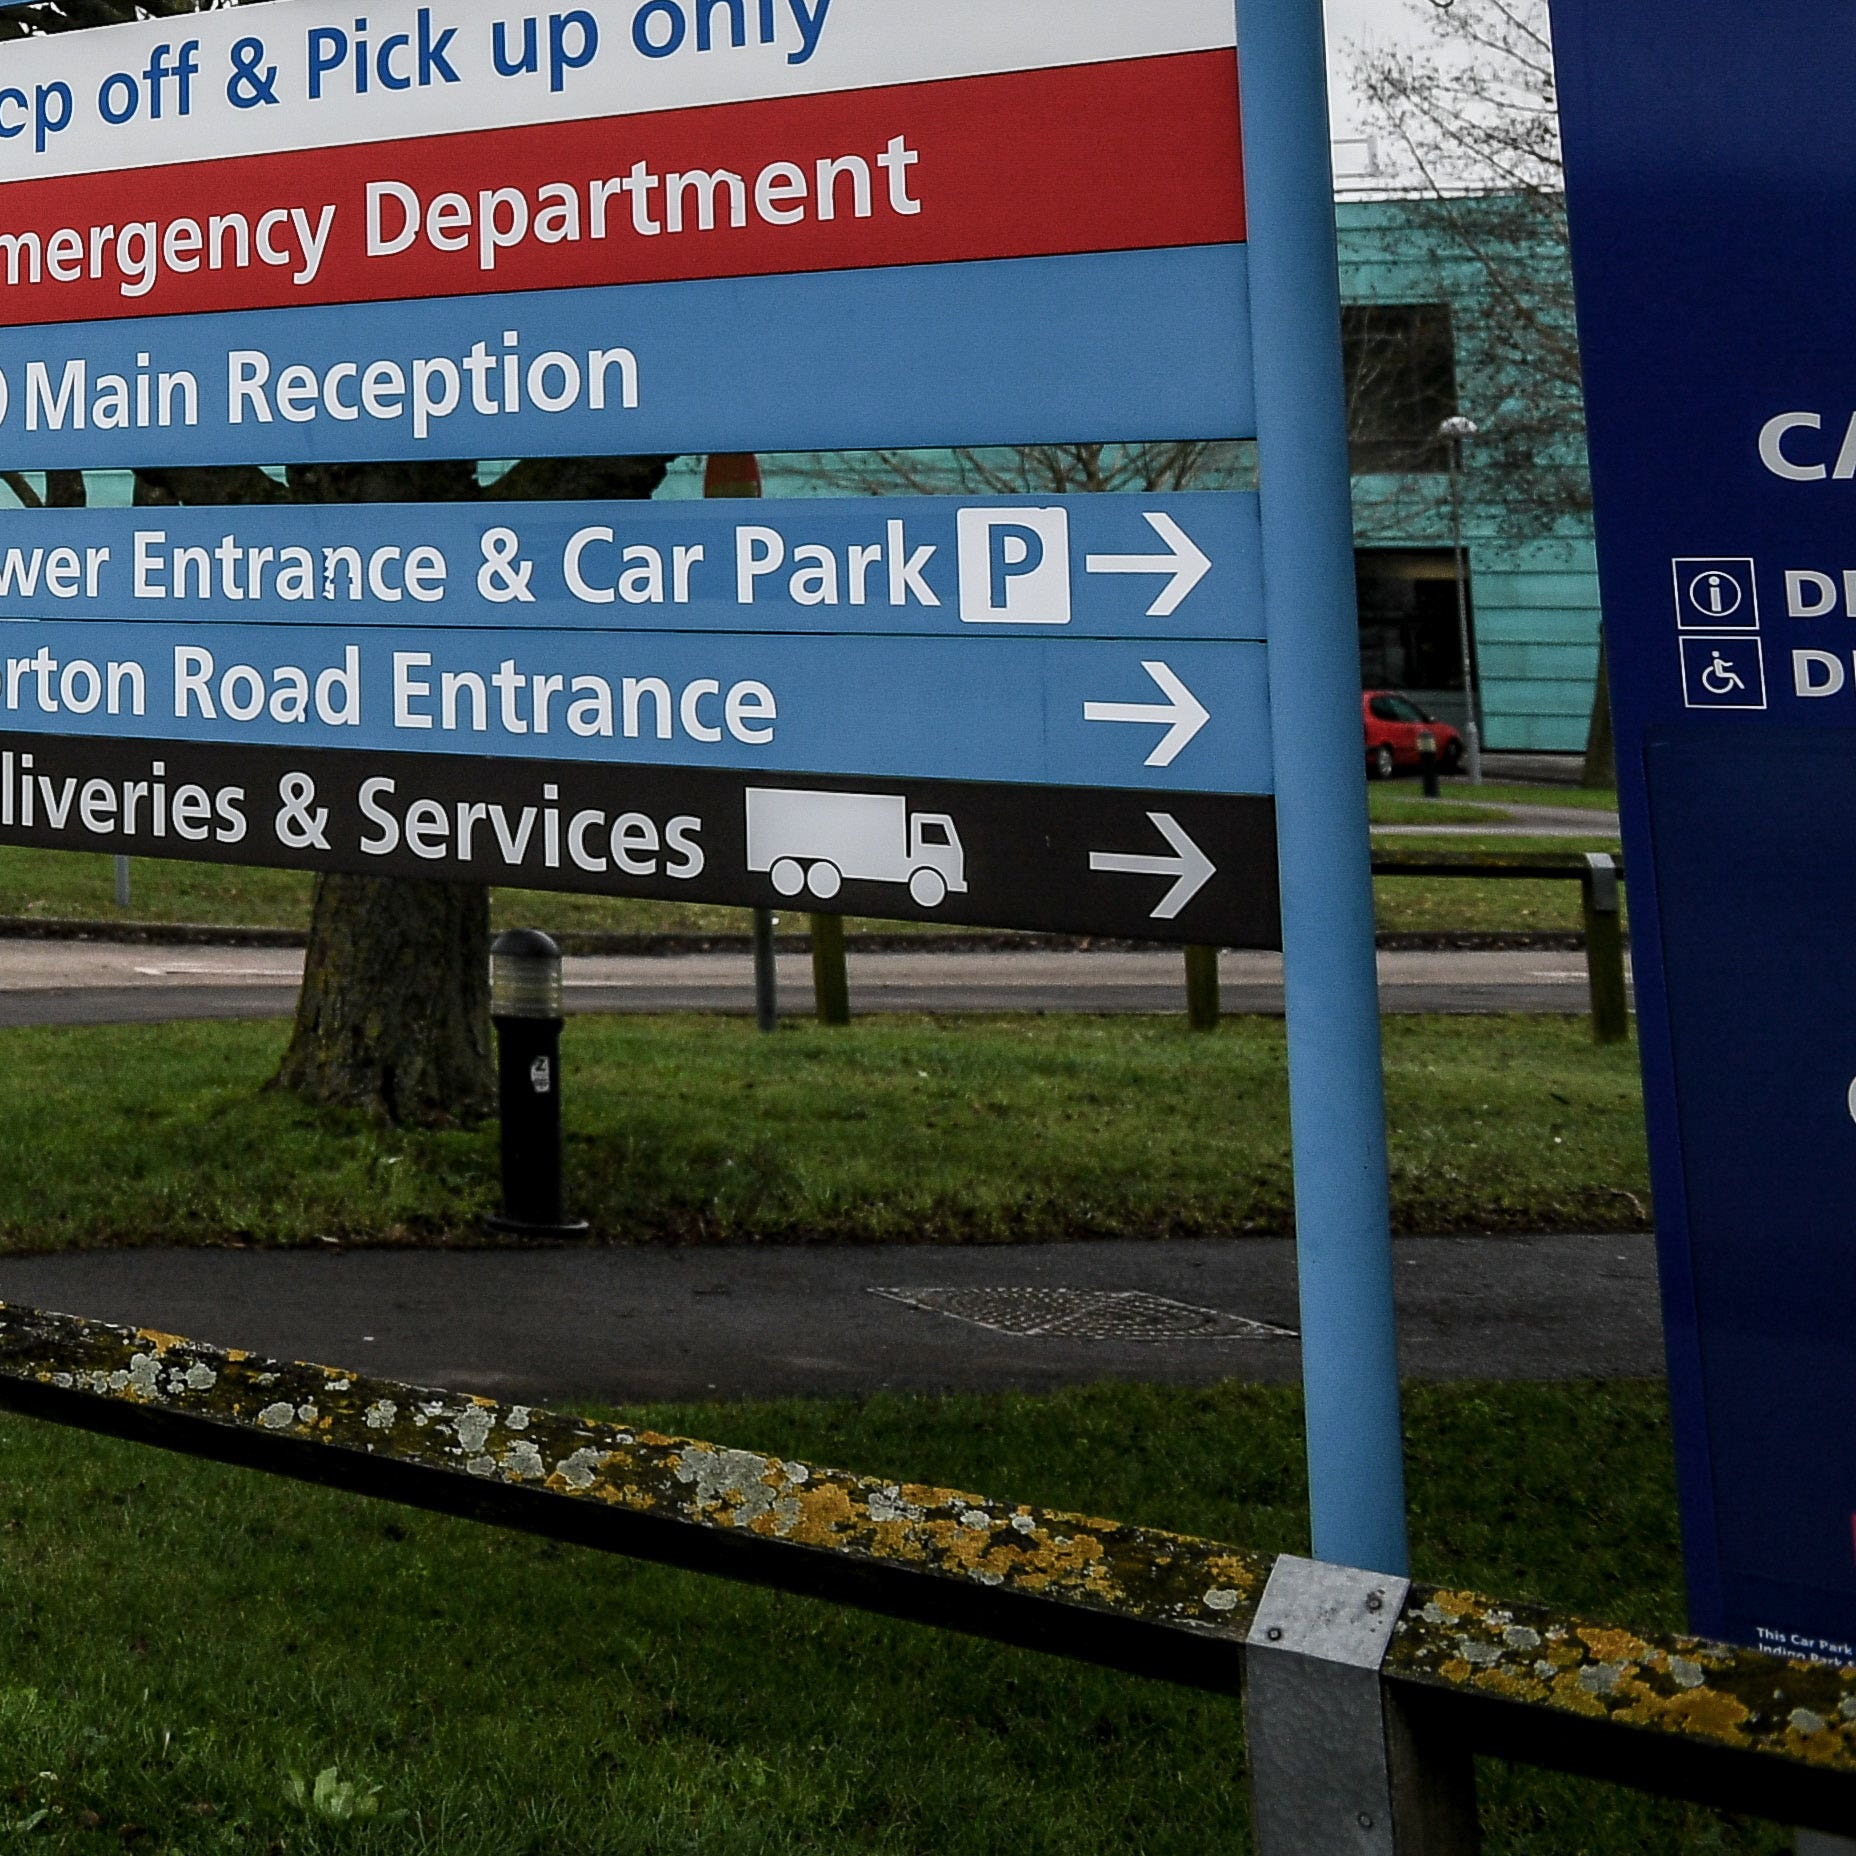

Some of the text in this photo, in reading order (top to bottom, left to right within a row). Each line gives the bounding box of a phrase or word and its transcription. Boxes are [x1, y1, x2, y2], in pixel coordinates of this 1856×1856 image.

[98, 39, 200, 126] off
[226, 35, 280, 110] &
[307, 6, 462, 101] Pick
[491, 5, 600, 94] up
[365, 134, 923, 271] Department
[24, 330, 639, 440] Main Reception
[133, 530, 448, 602] Entrance
[477, 526, 536, 603] &
[563, 526, 705, 604] Car
[735, 518, 941, 607] Park
[173, 644, 362, 724] Road
[392, 651, 777, 744] Entrance
[275, 771, 332, 851] &
[357, 776, 706, 879] Services
[1756, 1627, 1853, 1656] This Car Park
